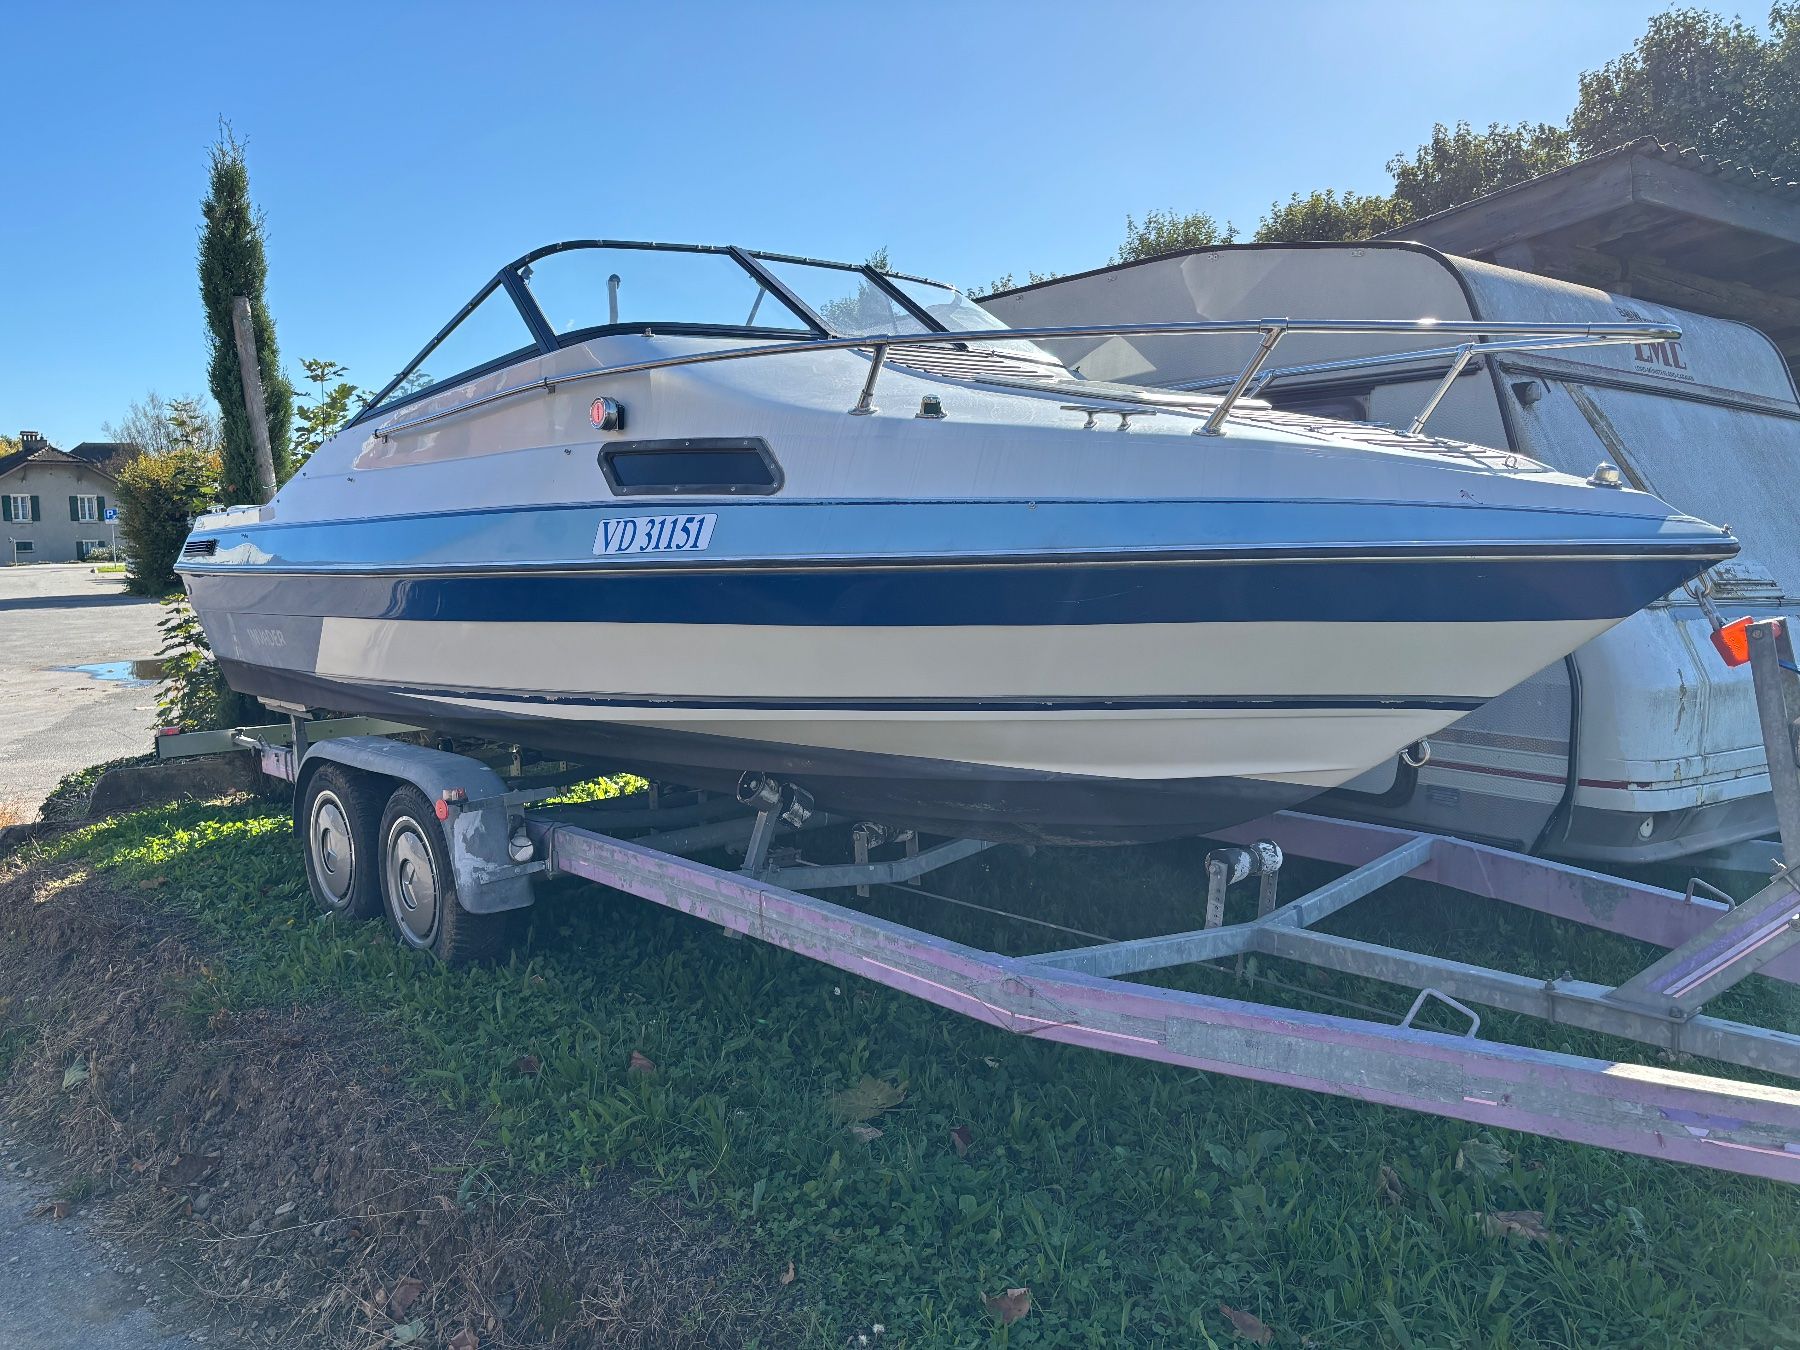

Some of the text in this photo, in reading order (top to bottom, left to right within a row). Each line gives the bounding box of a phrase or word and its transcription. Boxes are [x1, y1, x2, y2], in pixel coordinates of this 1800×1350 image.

[1634, 341, 1687, 370] LMC
[106, 510, 114, 519] P
[603, 516, 705, 552] VD 31151
